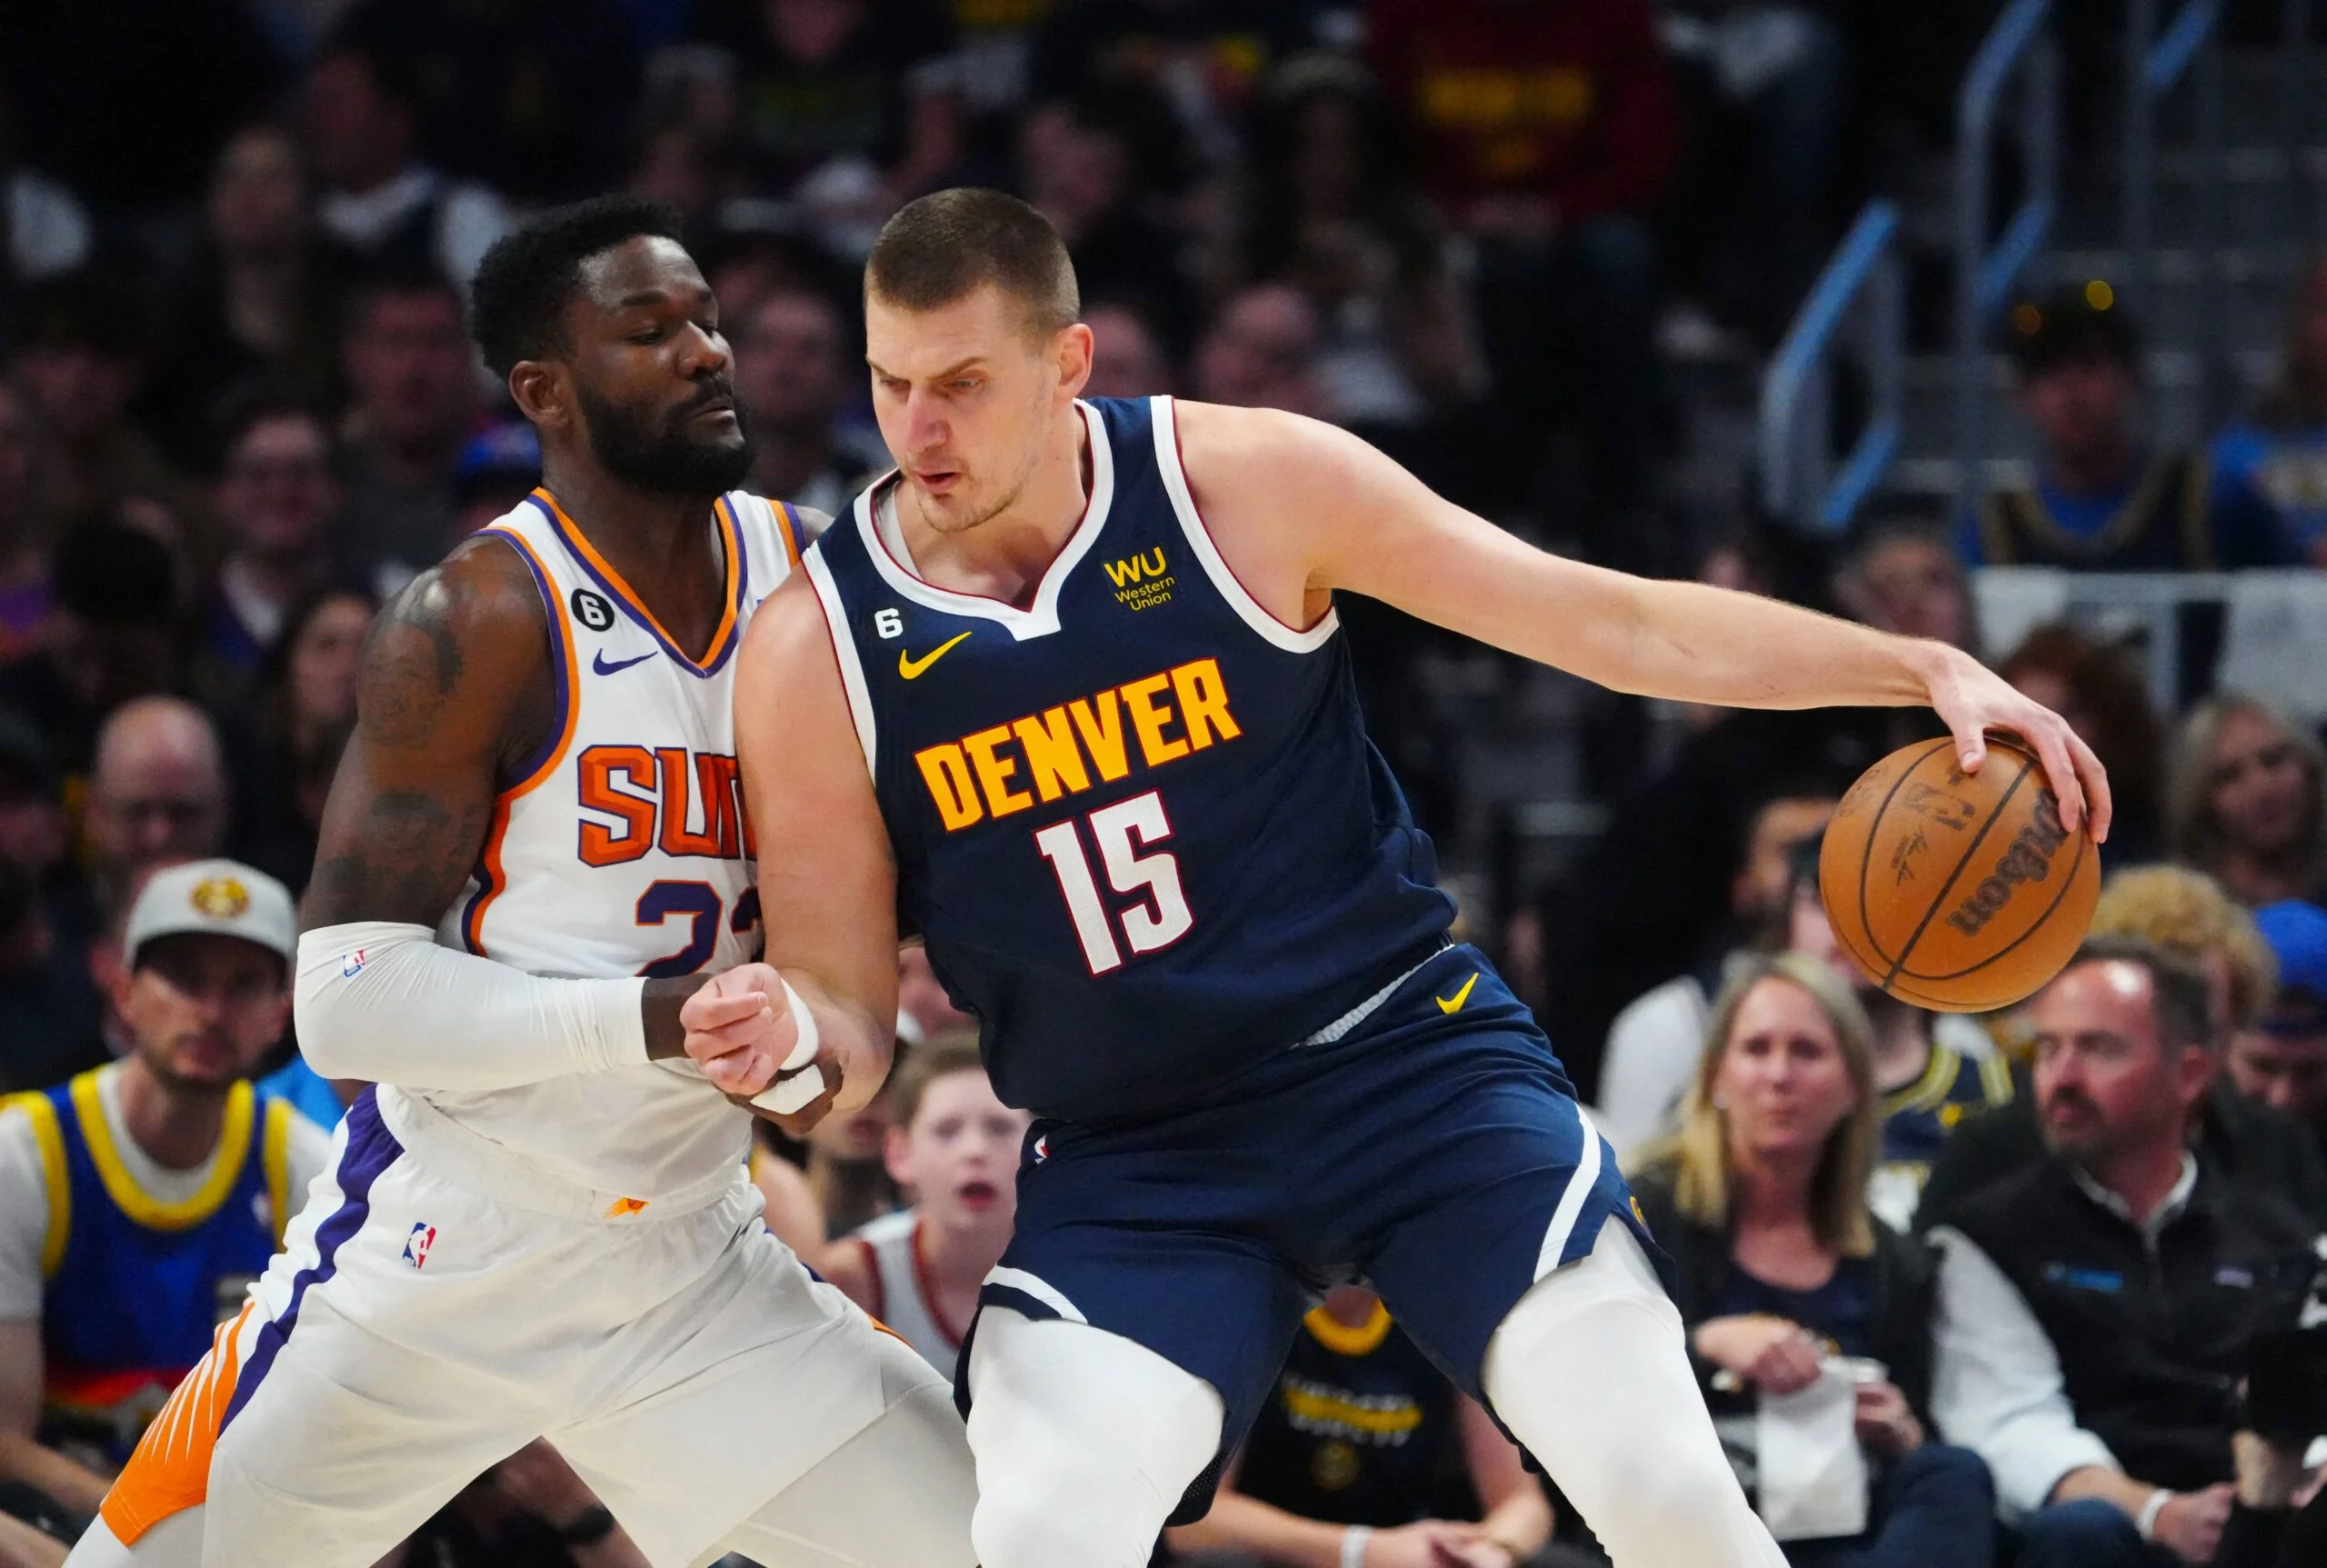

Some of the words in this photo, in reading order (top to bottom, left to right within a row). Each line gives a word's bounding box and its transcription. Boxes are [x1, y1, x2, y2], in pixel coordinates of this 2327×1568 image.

[1104, 546, 1166, 588] WU
[1114, 576, 1175, 604] Western
[1130, 592, 1172, 611] Union
[577, 593, 608, 627] 6
[874, 608, 903, 639] 6
[913, 656, 1244, 833] DENVER
[577, 744, 758, 868] SUN
[1032, 787, 1196, 979] 15
